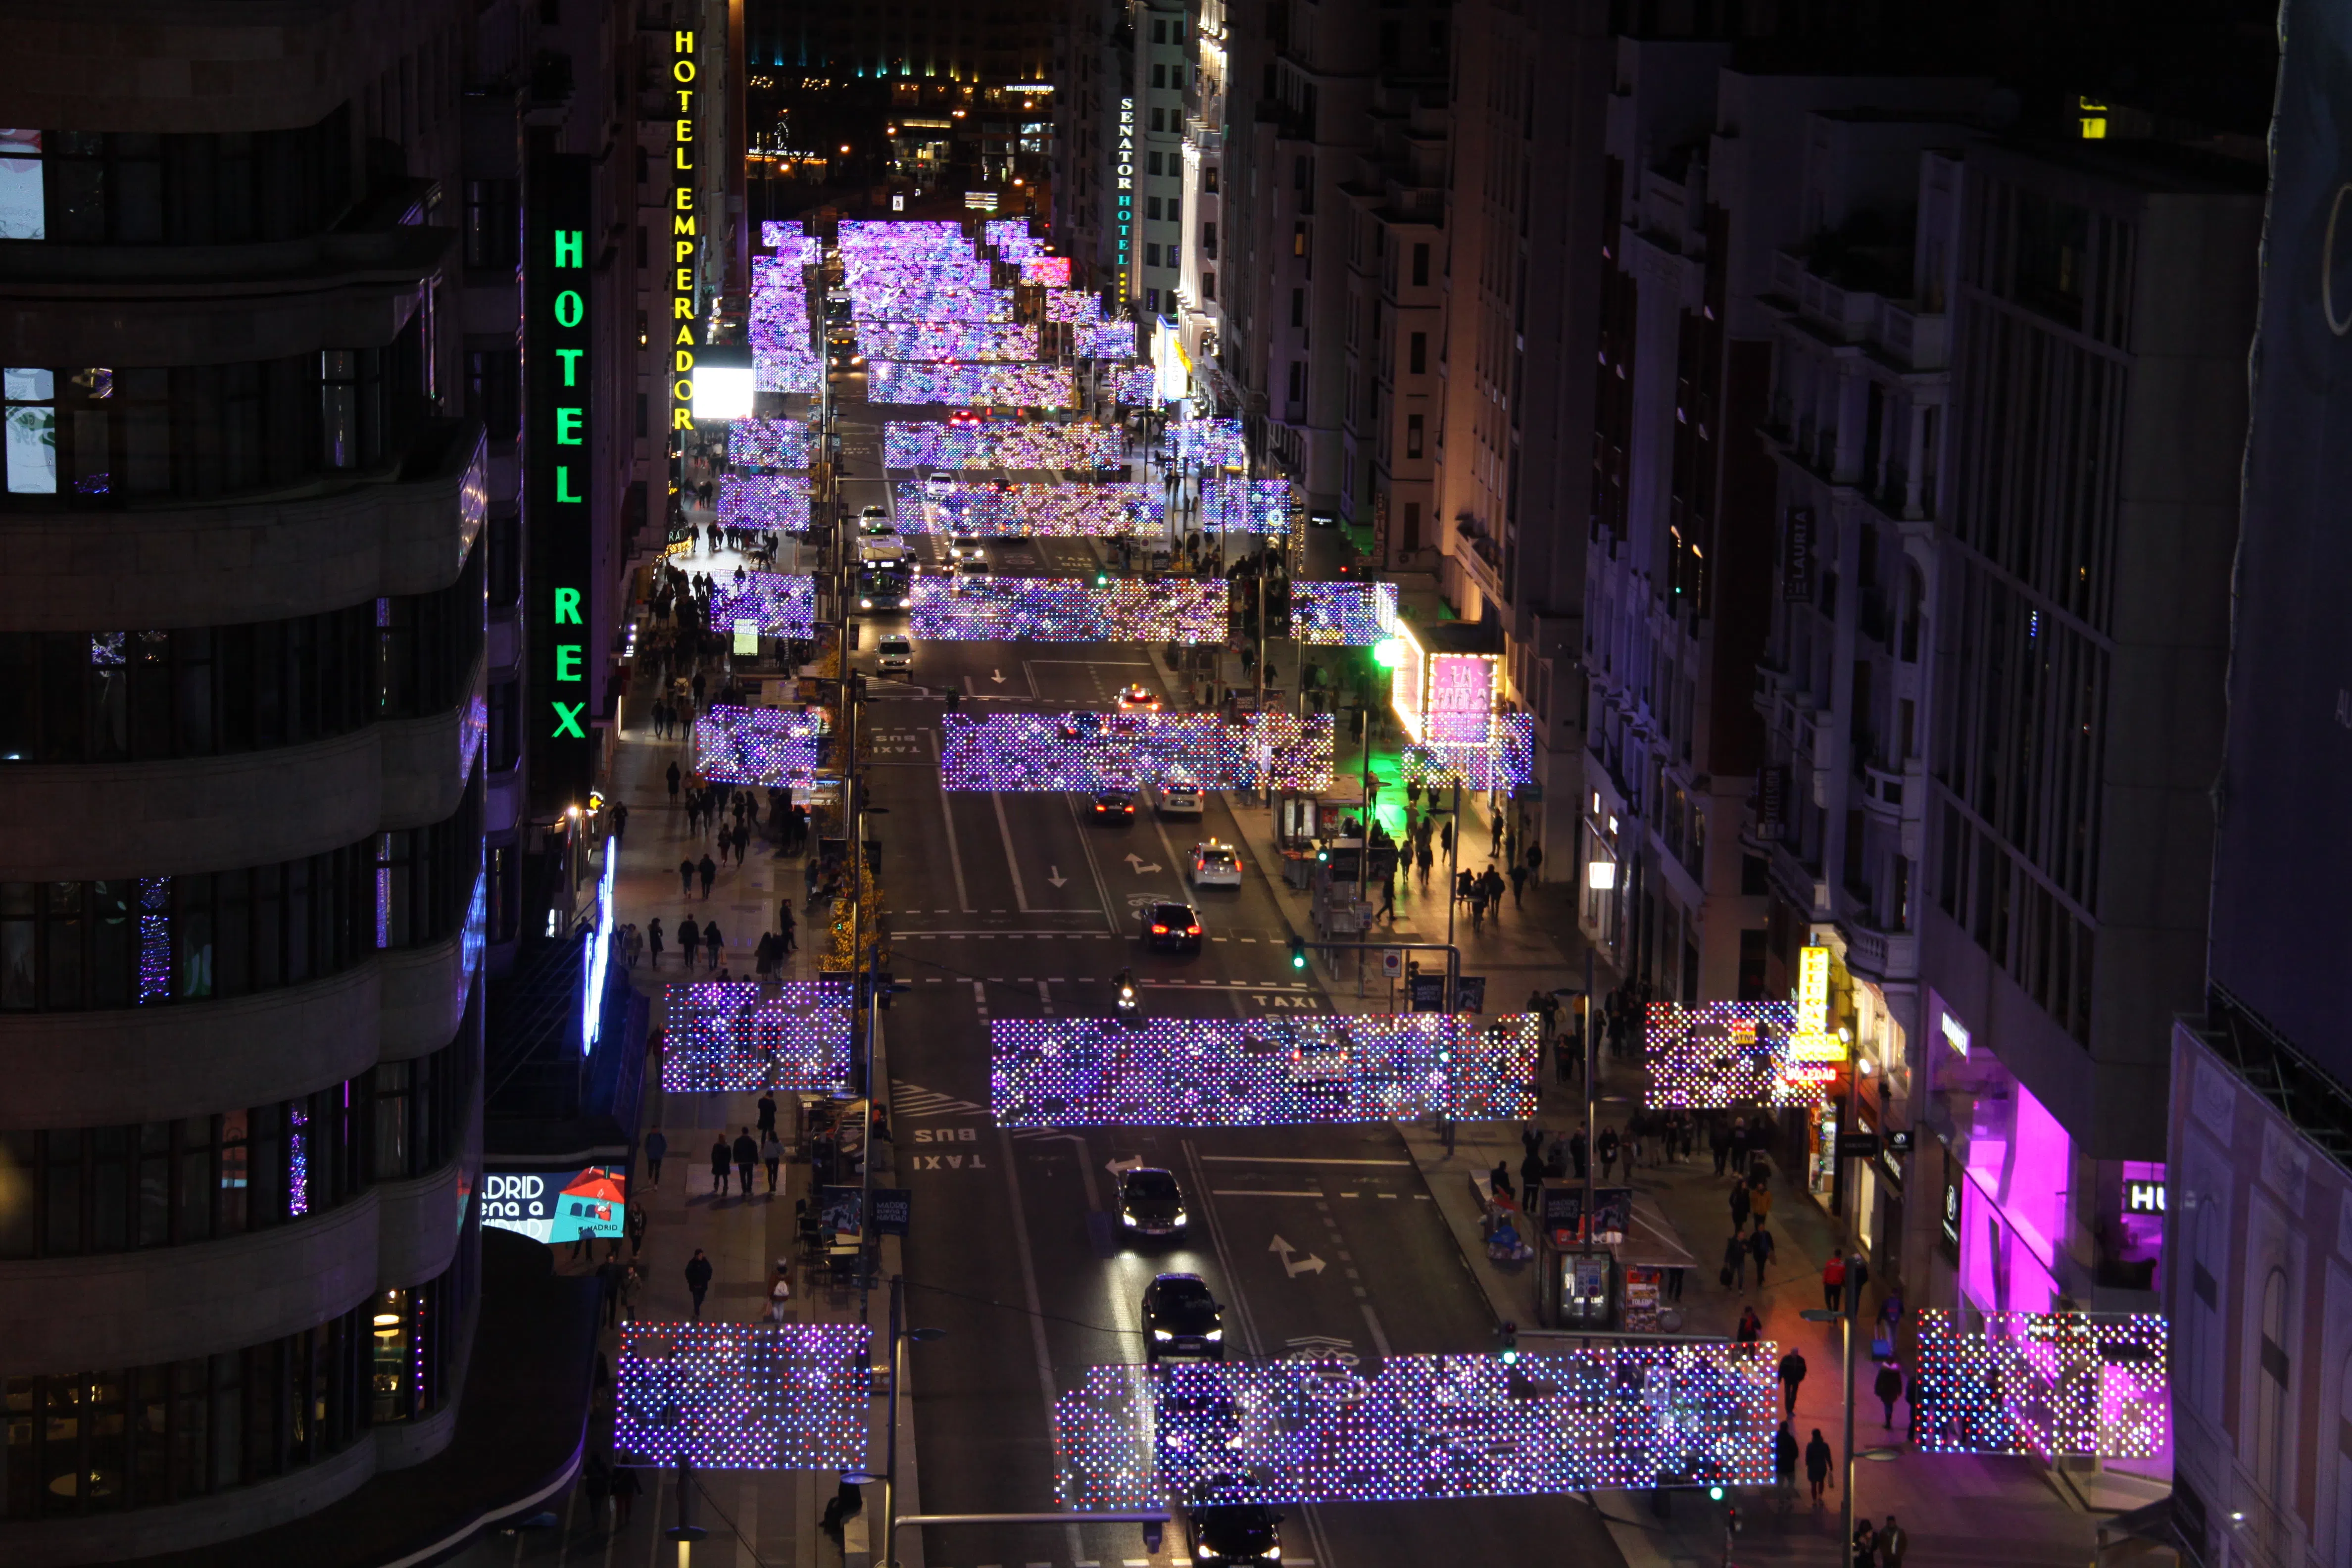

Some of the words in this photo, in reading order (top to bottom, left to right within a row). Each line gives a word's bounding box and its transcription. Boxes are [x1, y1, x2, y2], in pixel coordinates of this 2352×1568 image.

[674, 31, 695, 169] HOTEL
[1117, 98, 1133, 189] SENATOR
[1117, 196, 1132, 265] HOTEL
[674, 188, 696, 430] EMPERADOR
[555, 230, 583, 502] HOTEL
[1792, 510, 1807, 579] LAURIA
[552, 588, 585, 737] REX
[1451, 666, 1472, 687] LA
[1433, 688, 1487, 710] JAULA
[1252, 995, 1318, 1008] TAXI
[1785, 1068, 1836, 1081] SOLEDAD
[915, 1128, 977, 1142] BUS
[913, 1154, 986, 1170] TAXI
[482, 1176, 544, 1199] DRID
[528, 1201, 544, 1216] a
